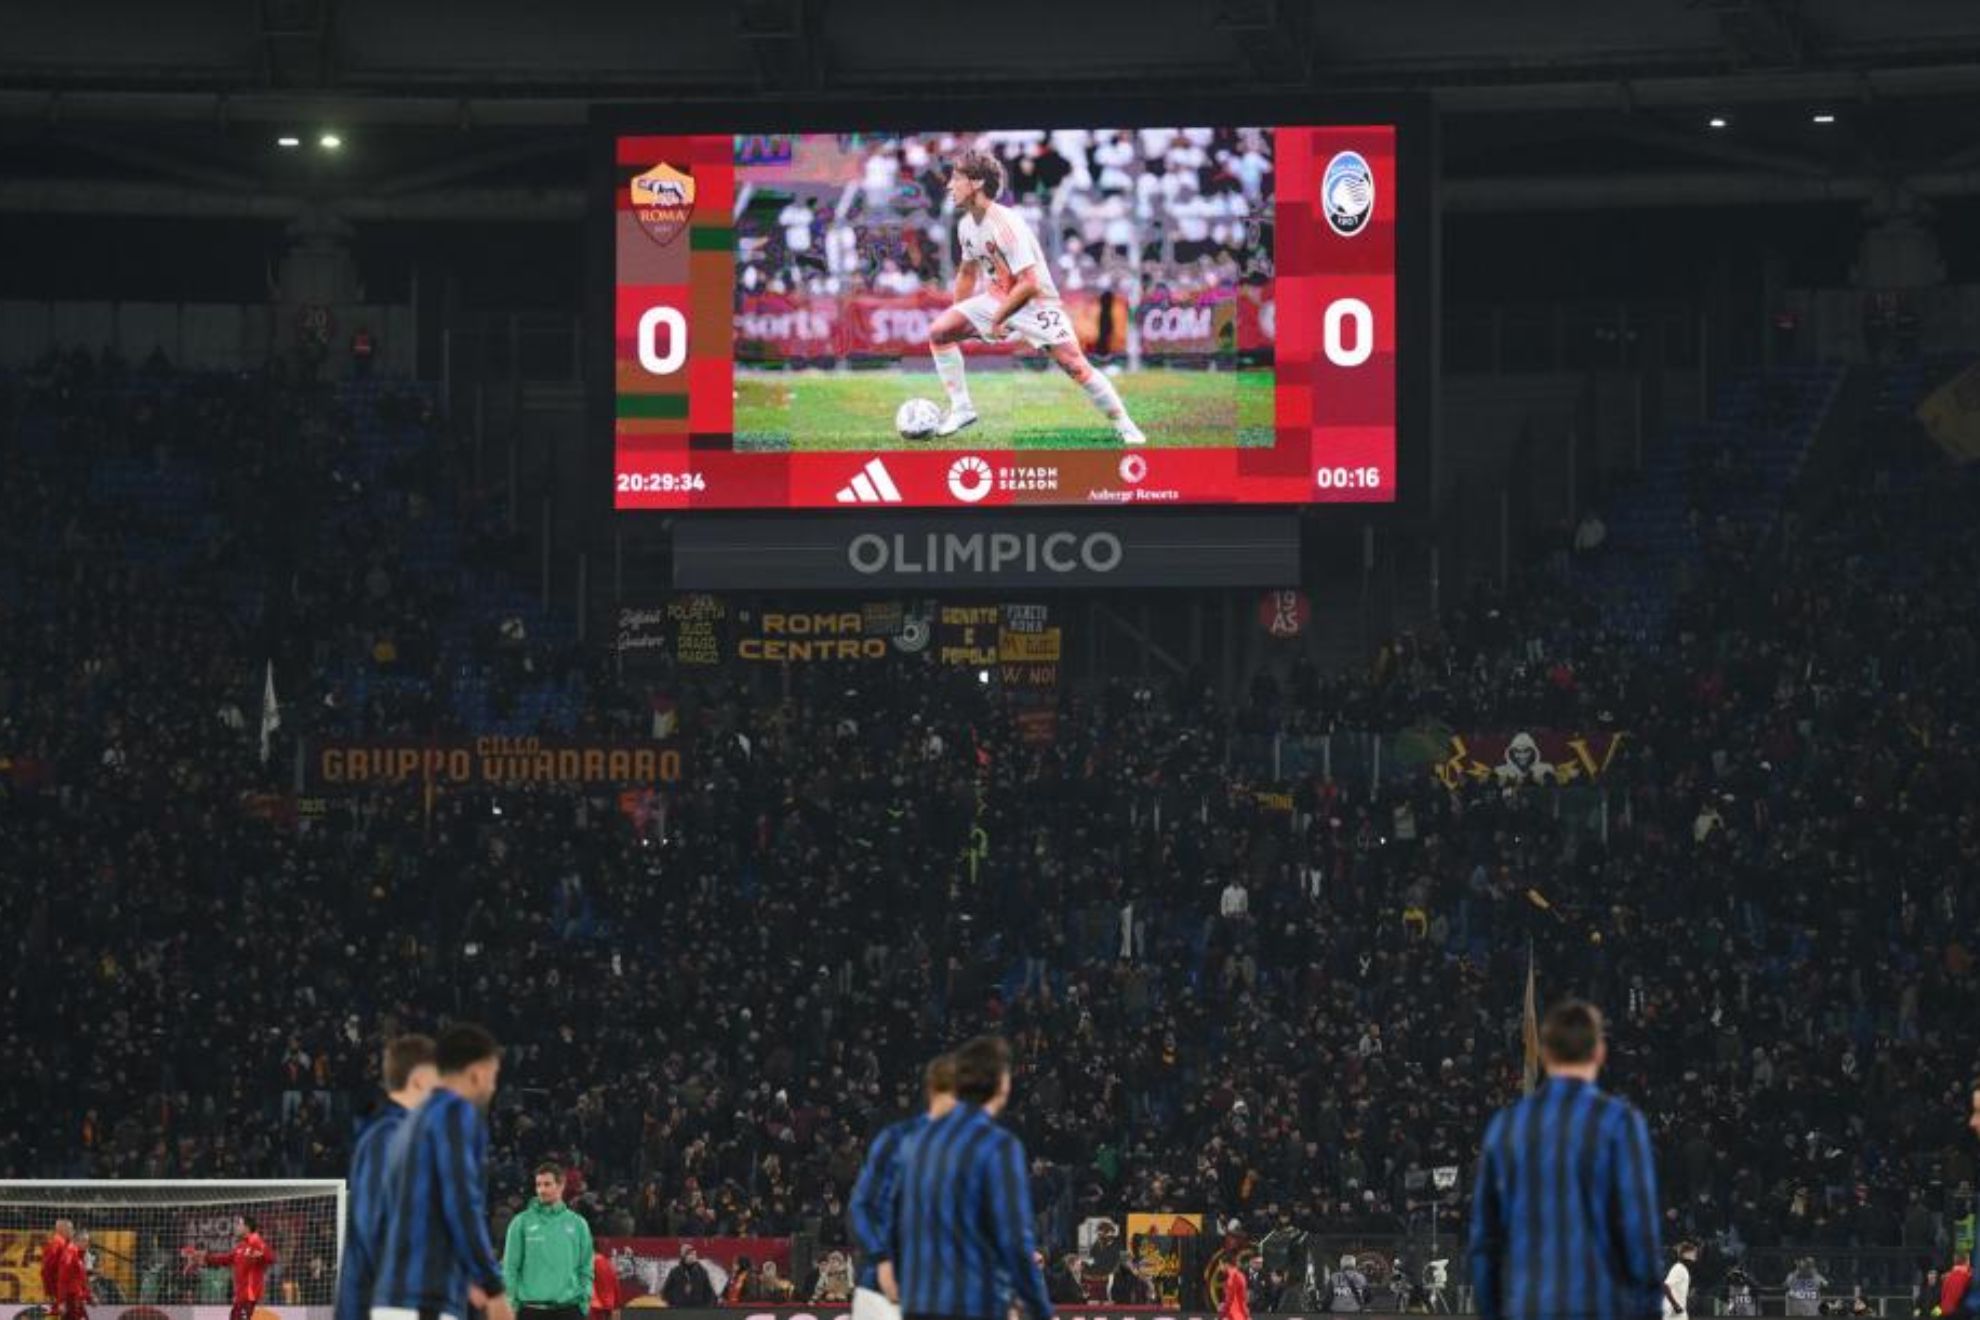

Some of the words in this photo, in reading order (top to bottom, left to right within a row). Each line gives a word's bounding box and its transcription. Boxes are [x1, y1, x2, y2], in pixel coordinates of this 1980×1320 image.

[641, 209, 687, 222] ROMA
[1037, 311, 1060, 329] 52
[637, 306, 687, 375] 0
[1323, 298, 1374, 367] 0
[617, 473, 705, 492] 20:29:34
[999, 467, 1058, 478] RIYADH
[1317, 467, 1380, 488] 00:16
[999, 480, 1058, 490] SEASON
[1088, 489, 1132, 501] Auberge
[1136, 489, 1179, 500] Resorts
[848, 532, 1123, 574] OLIMPICO
[761, 613, 862, 633] ROMA
[1268, 611, 1300, 635] AS
[738, 639, 887, 660] CENTRO
[322, 748, 470, 781] GRUPPO
